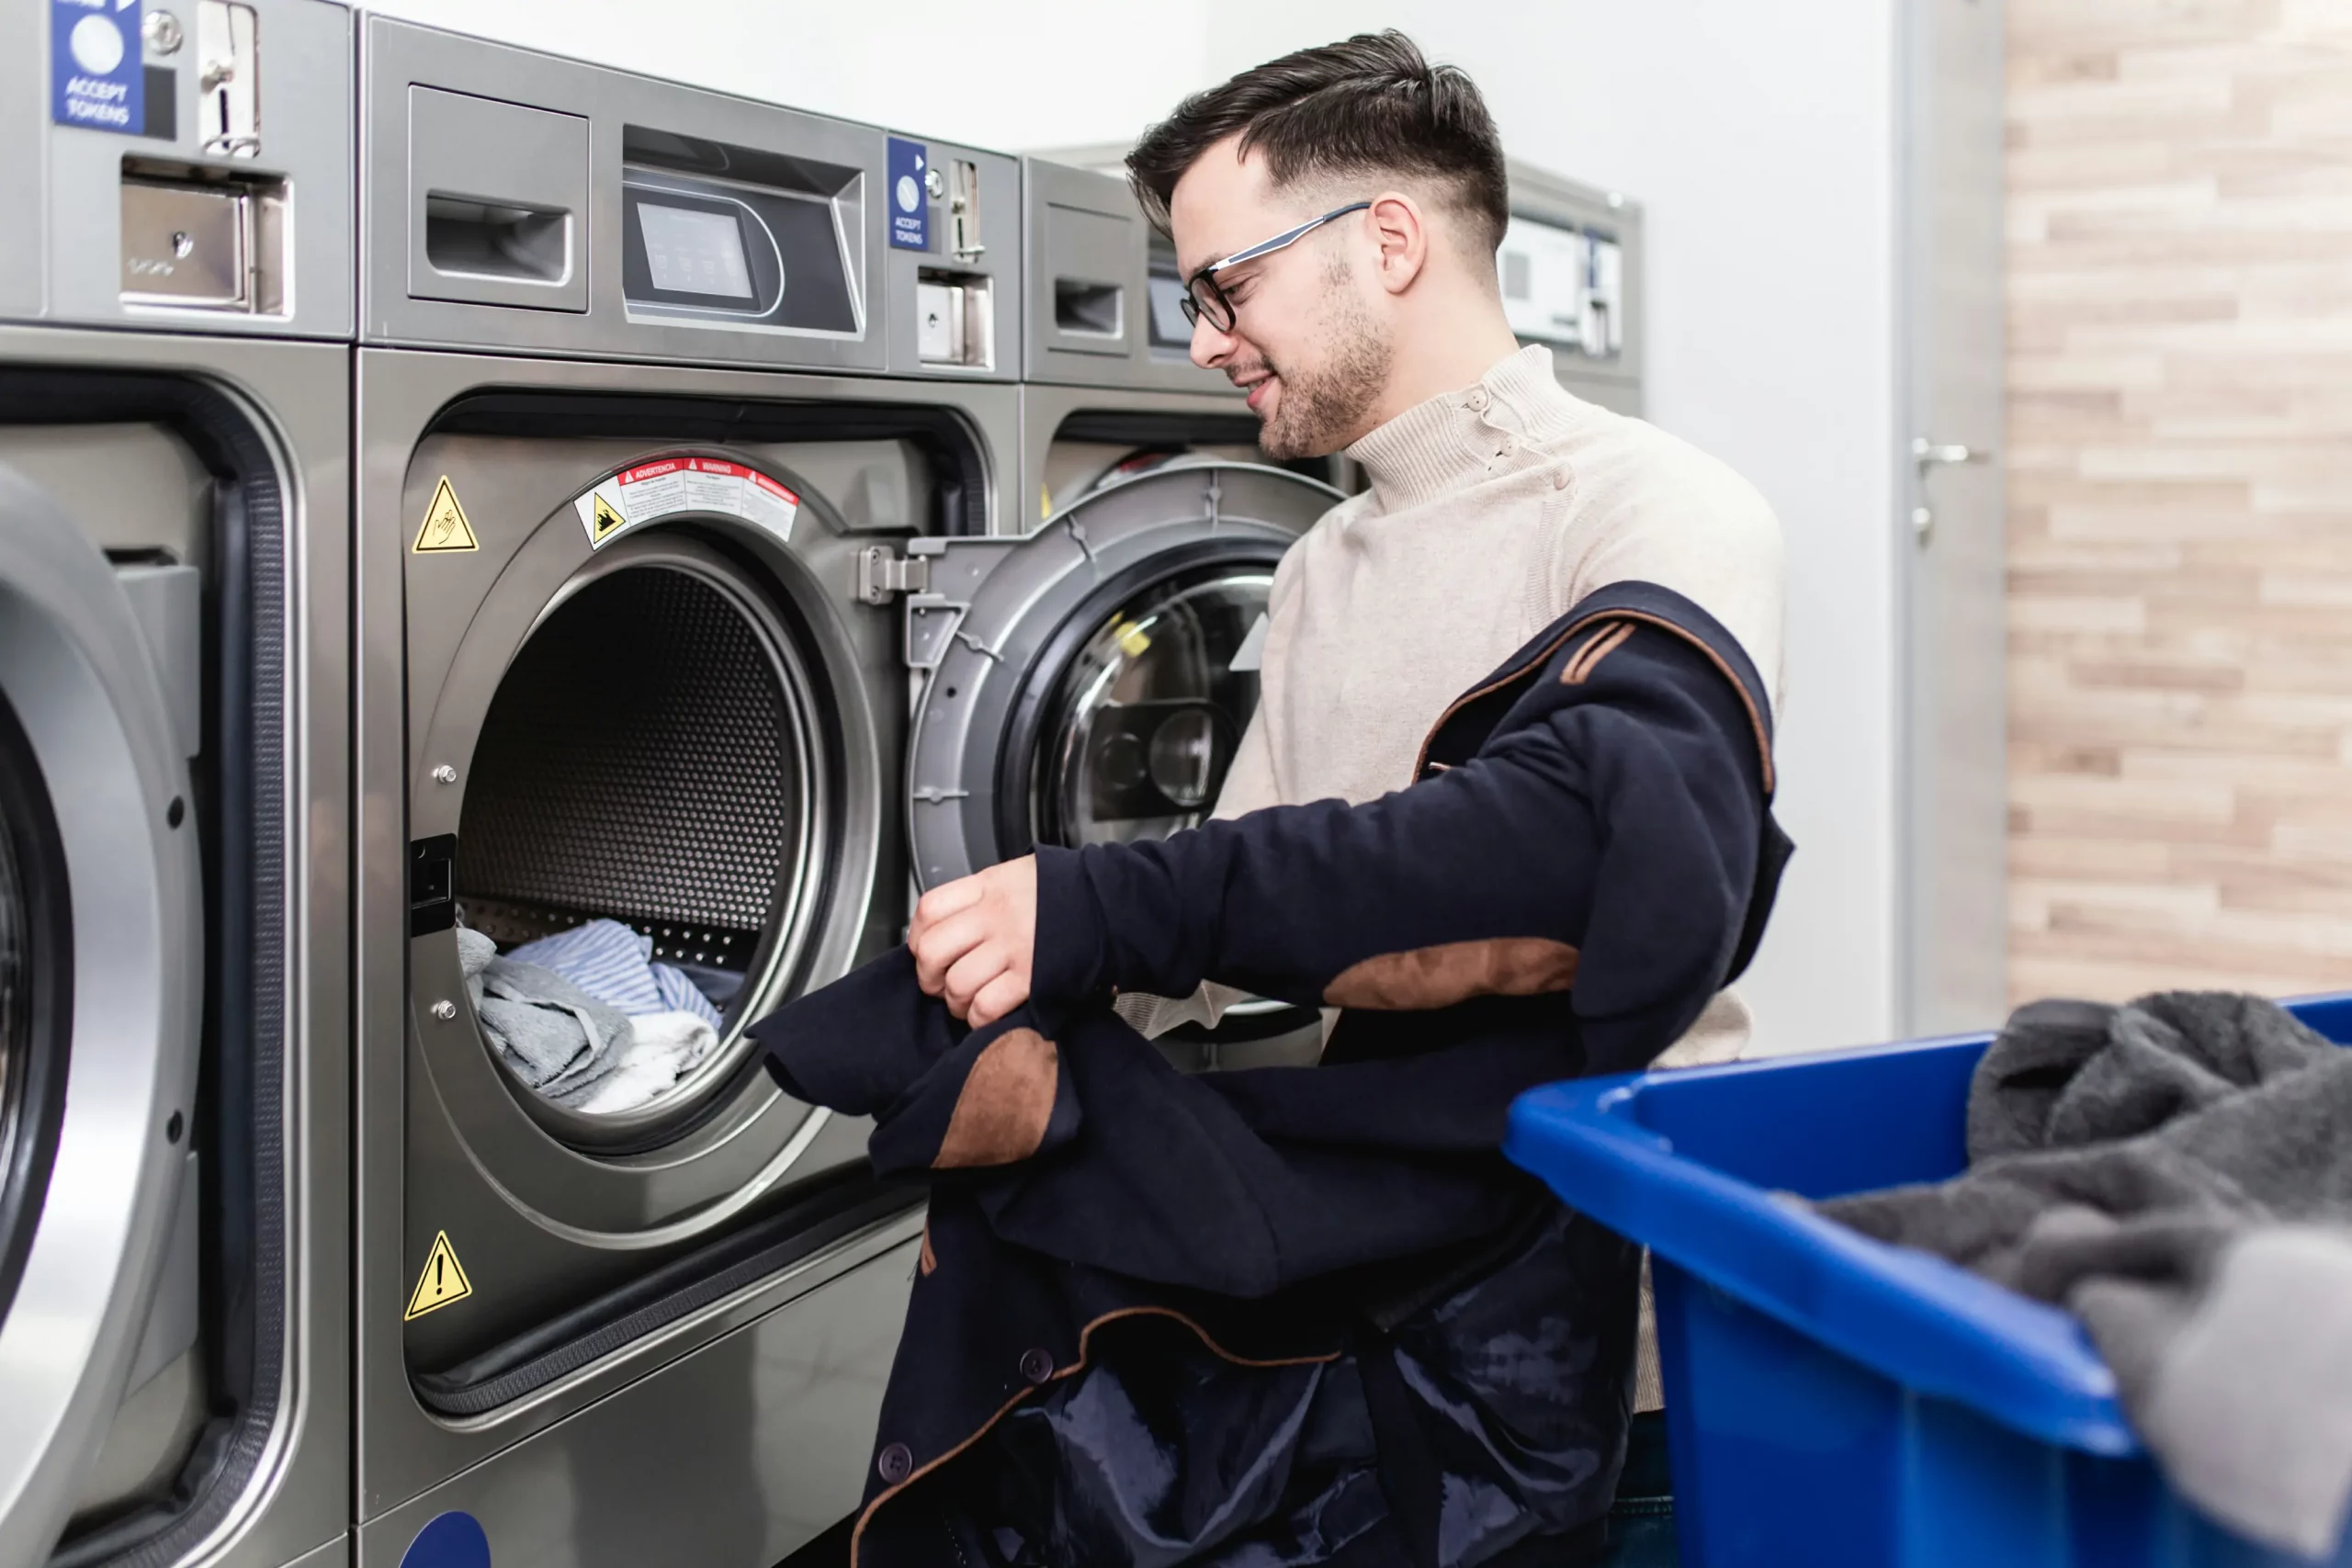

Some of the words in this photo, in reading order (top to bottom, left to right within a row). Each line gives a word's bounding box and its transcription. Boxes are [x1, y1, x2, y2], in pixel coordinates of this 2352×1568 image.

[65, 76, 128, 103] ACCEPT
[67, 98, 130, 126] TOKENS
[895, 217, 922, 231] ACCEPT
[896, 230, 923, 244] TOKENS
[635, 463, 676, 479] ADVERTENCIA
[702, 462, 731, 474] WARNING
